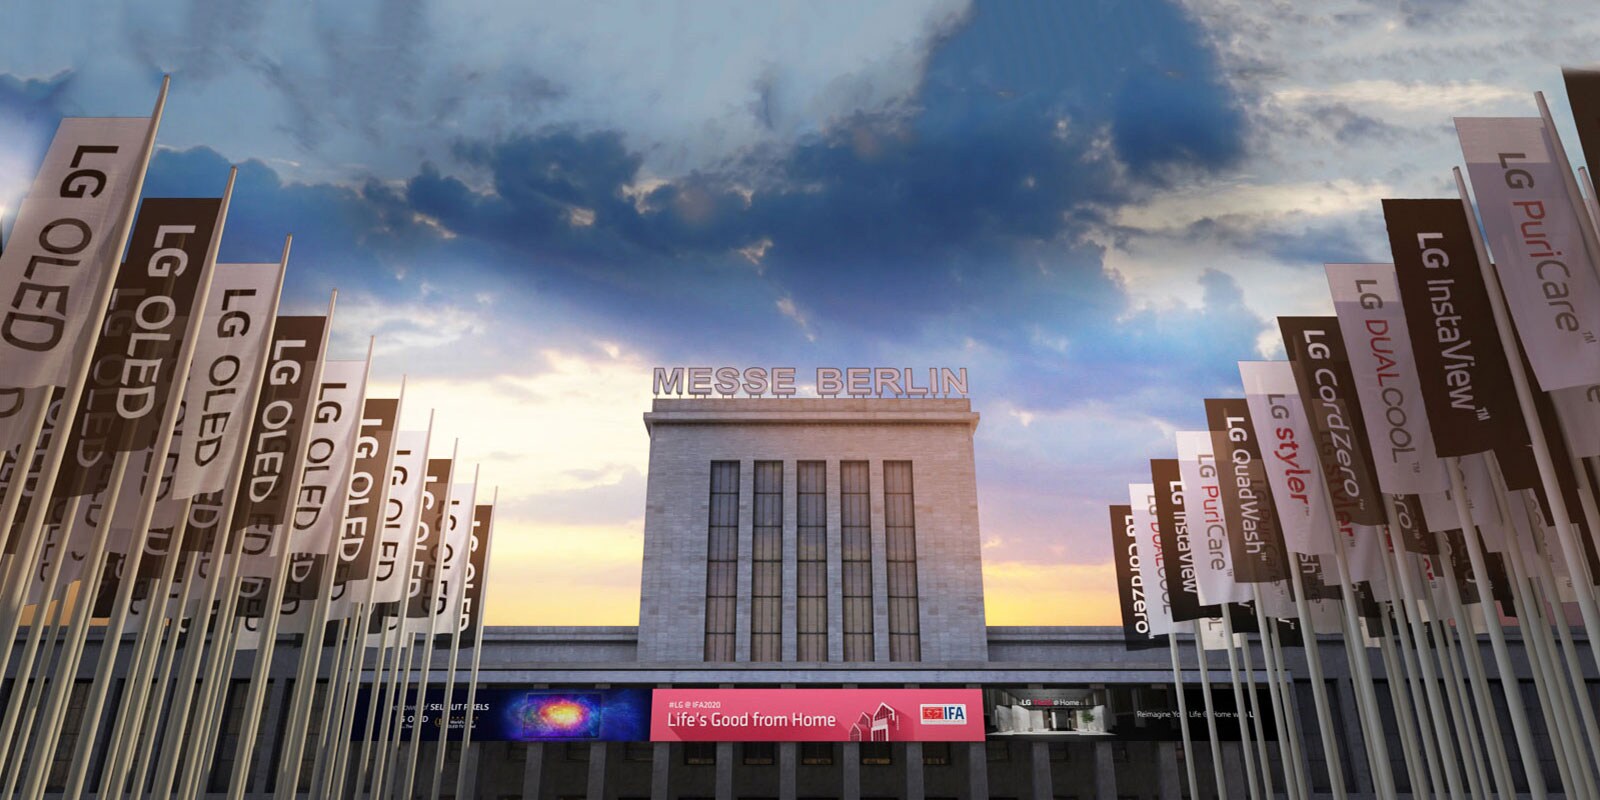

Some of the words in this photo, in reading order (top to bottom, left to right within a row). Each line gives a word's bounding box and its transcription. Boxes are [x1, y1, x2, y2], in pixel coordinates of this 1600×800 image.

[60, 145, 119, 199] LG
[1498, 152, 1535, 190] LG
[147, 224, 196, 277] LG
[1416, 231, 1451, 269] LG
[1, 217, 93, 352] OLED
[1355, 279, 1384, 310] LG
[217, 288, 257, 338] LG
[115, 295, 177, 419] OLED
[270, 339, 307, 386] LG
[1303, 329, 1332, 361] LG
[652, 366, 796, 395] MESSE
[816, 366, 969, 395] BERLIN
[194, 355, 241, 467] OLED
[313, 382, 348, 424] LG
[1266, 393, 1290, 420] LG
[355, 418, 383, 459] LG
[1226, 416, 1248, 443] LG
[249, 400, 294, 503] OLED
[1198, 453, 1216, 480] LG
[293, 437, 336, 531] OLED
[1169, 480, 1186, 506] LG
[339, 471, 374, 562] OLED
[1172, 511, 1198, 594] InstaView
[1128, 543, 1150, 635] CordZero
[407, 715, 429, 723] OD
[463, 703, 490, 712] PXELS
[667, 711, 708, 727] Life's
[711, 711, 749, 728] Good
[752, 711, 788, 727] from
[792, 711, 837, 727] Home
[668, 700, 684, 709] #LG
[684, 700, 691, 709] @
[692, 700, 722, 709] IFA2020
[943, 706, 966, 720] IFA
[1060, 698, 1081, 706] Home
[1135, 710, 1171, 719] Reimagine
[1188, 710, 1202, 718] Life
